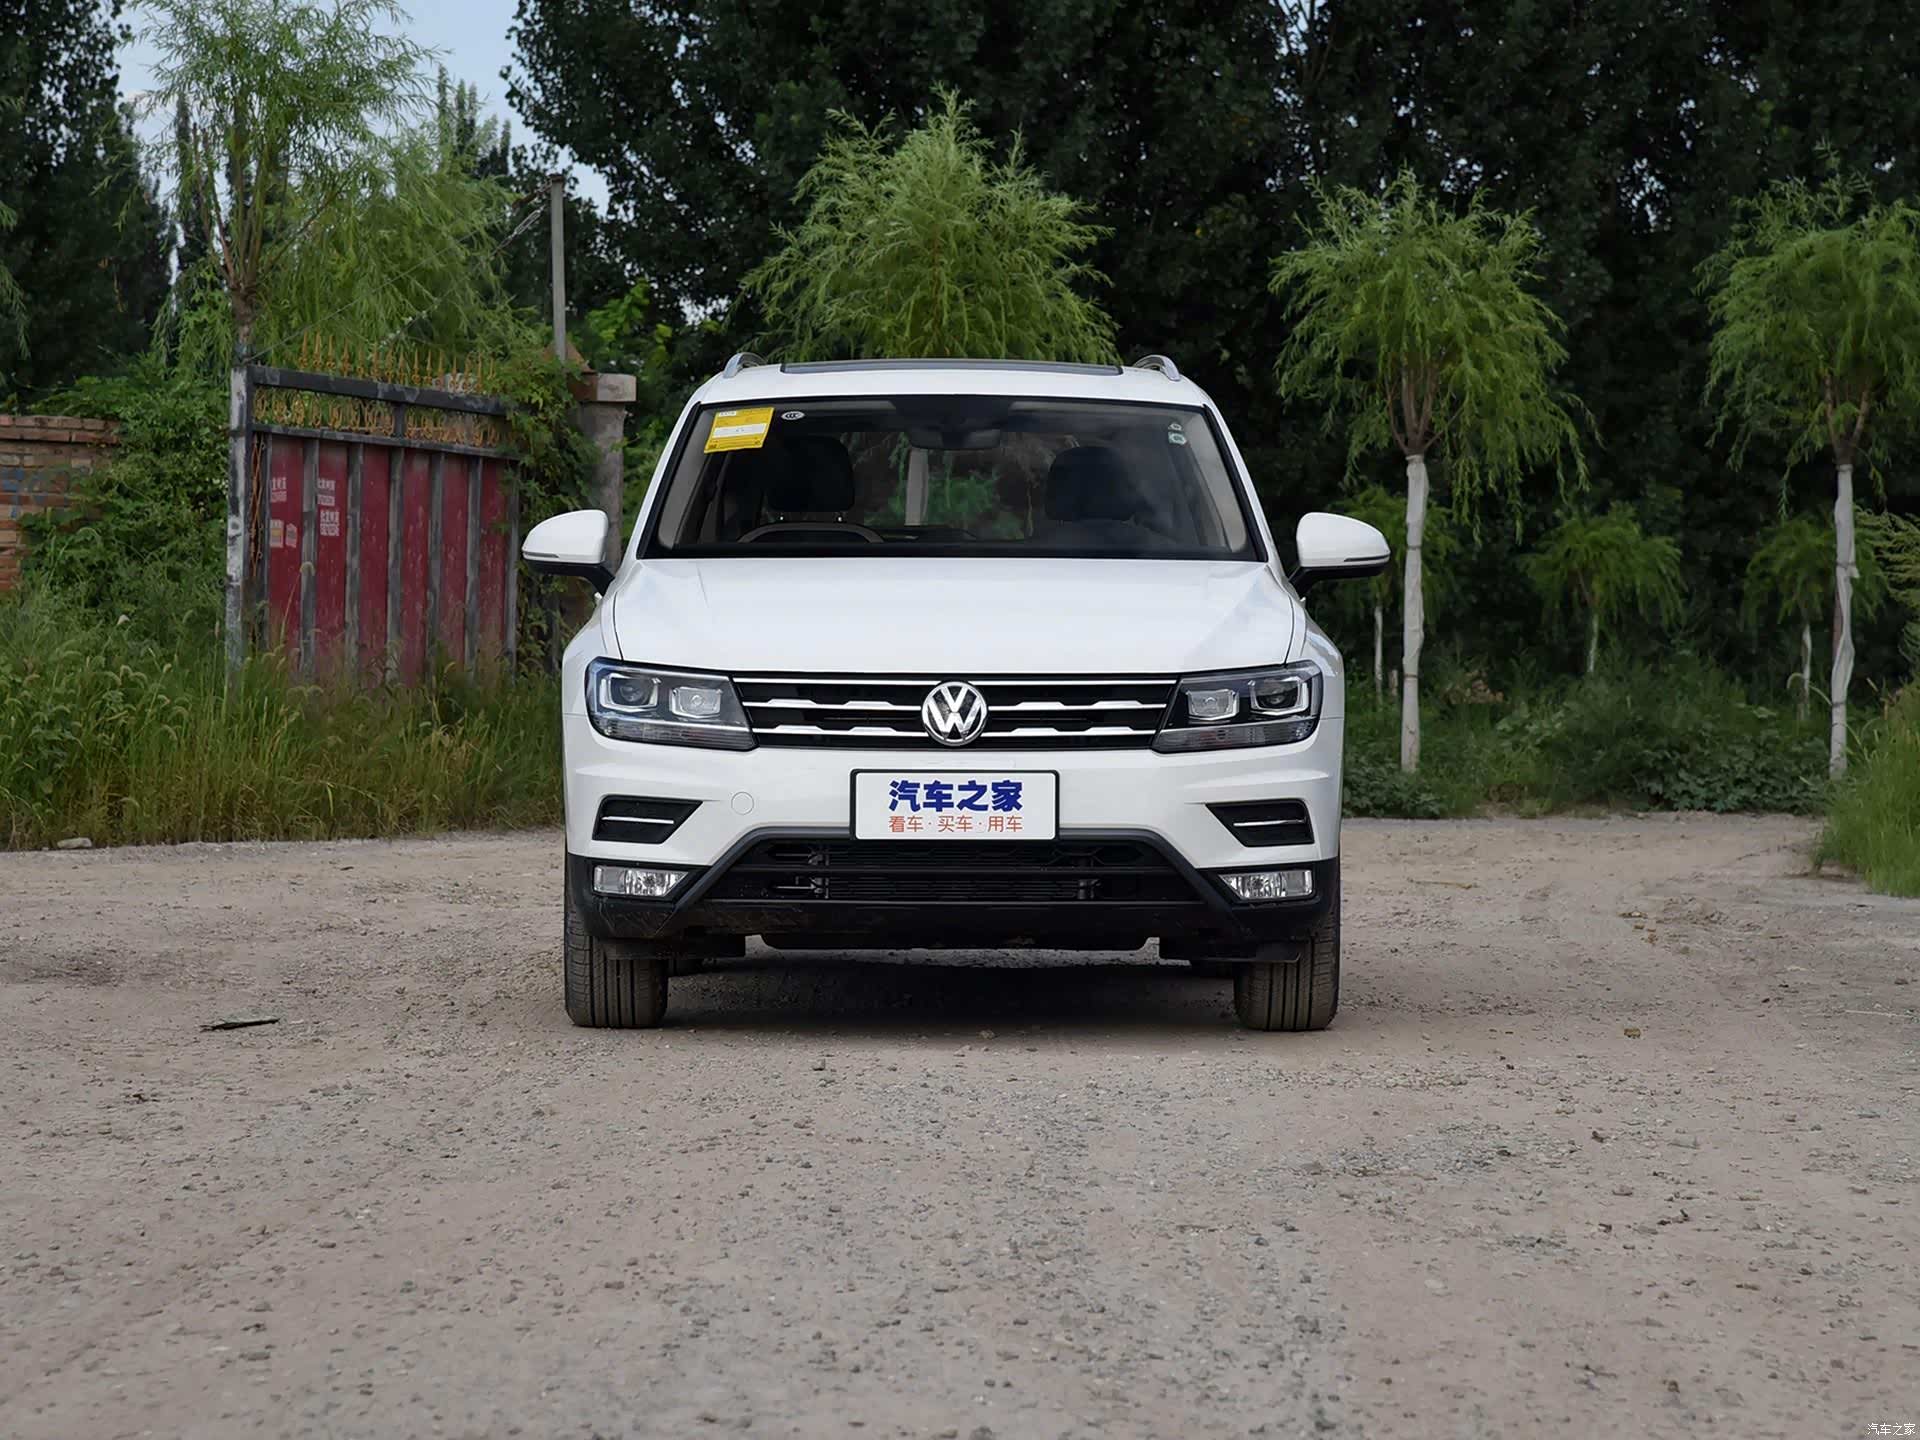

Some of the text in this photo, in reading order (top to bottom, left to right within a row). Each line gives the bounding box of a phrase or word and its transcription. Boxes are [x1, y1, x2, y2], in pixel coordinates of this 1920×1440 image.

[924, 683, 985, 743] VW
[889, 780, 1023, 812] 汽车之家
